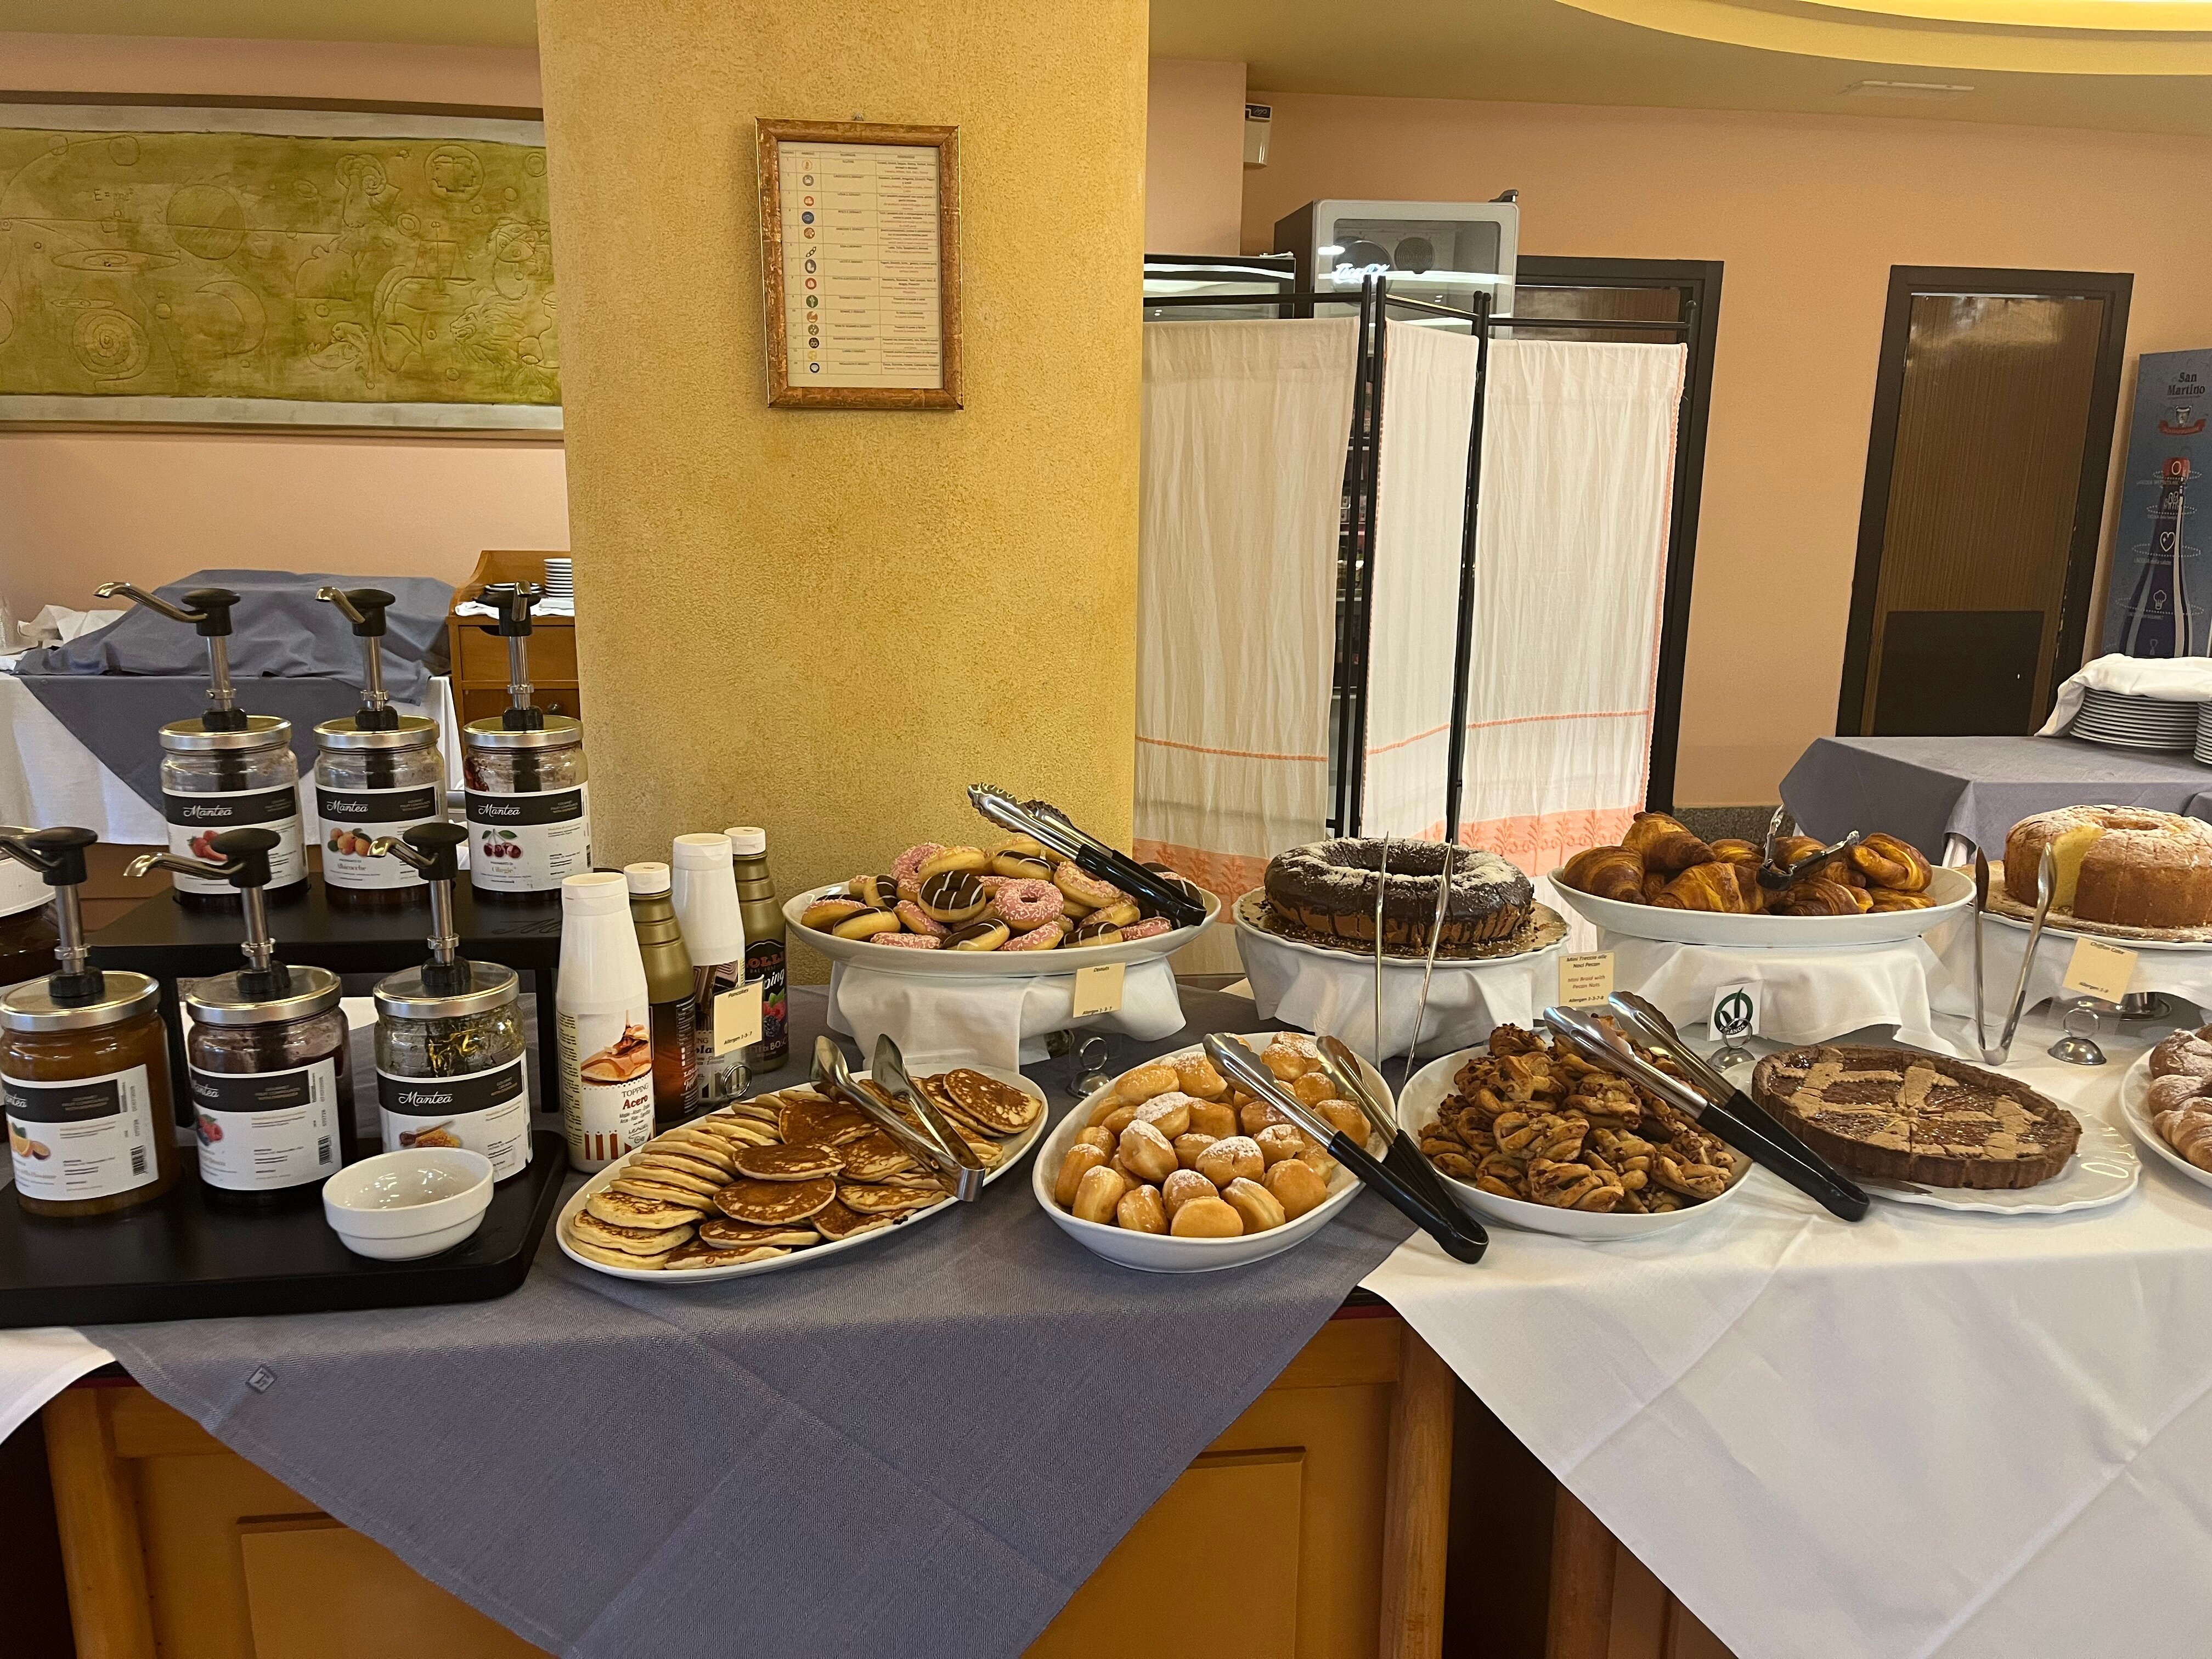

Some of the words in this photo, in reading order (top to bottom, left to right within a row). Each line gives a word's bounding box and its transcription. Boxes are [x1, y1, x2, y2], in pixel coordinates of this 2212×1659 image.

[94, 188, 102, 201] E
[2178, 372, 2197, 382] San
[2166, 384, 2205, 396] Martino
[183, 805, 233, 819] Mantea
[326, 800, 369, 814] Mantea
[478, 804, 521, 817] Mantea
[1719, 1023, 1746, 1035] VGANOK
[191, 1080, 219, 1098] antea
[622, 1082, 649, 1097] TOPPING
[5, 1093, 27, 1108] antea
[398, 1091, 453, 1107] Mantea
[622, 1094, 648, 1110] Acero
